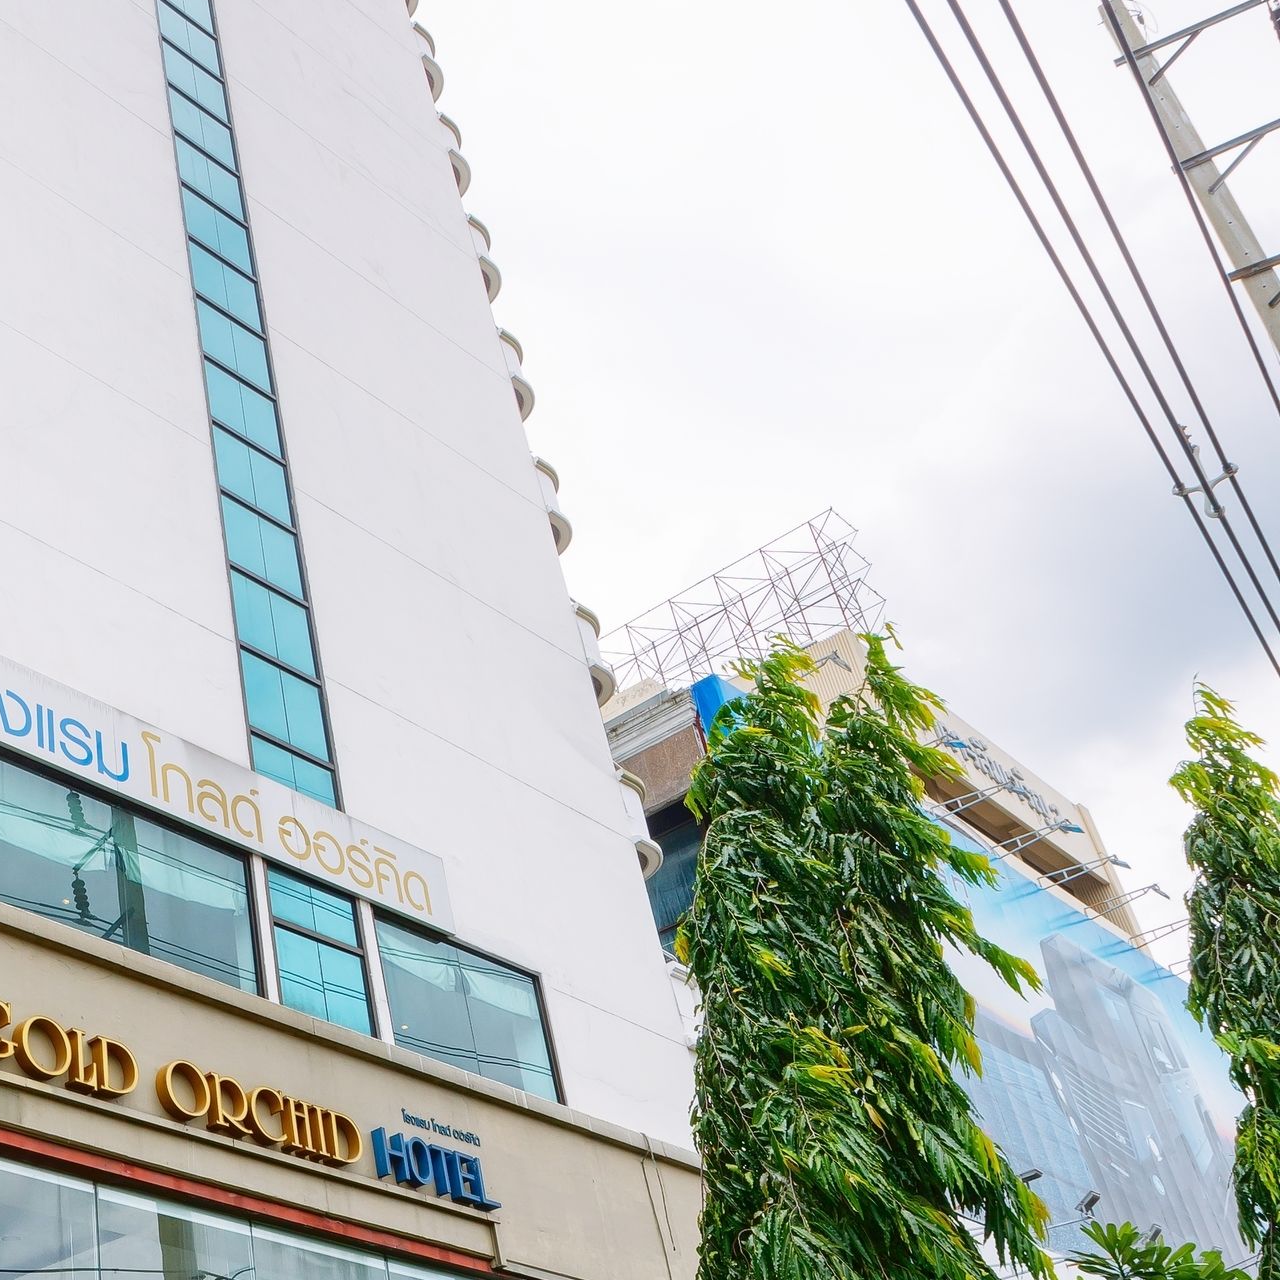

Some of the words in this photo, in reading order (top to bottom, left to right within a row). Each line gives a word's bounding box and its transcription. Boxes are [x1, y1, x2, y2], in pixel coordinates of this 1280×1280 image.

[141, 730, 264, 844] โกลด์
[278, 815, 433, 916] ออร์คิด
[155, 1059, 363, 1167] ORCHID
[370, 1126, 502, 1212] HOTEL
